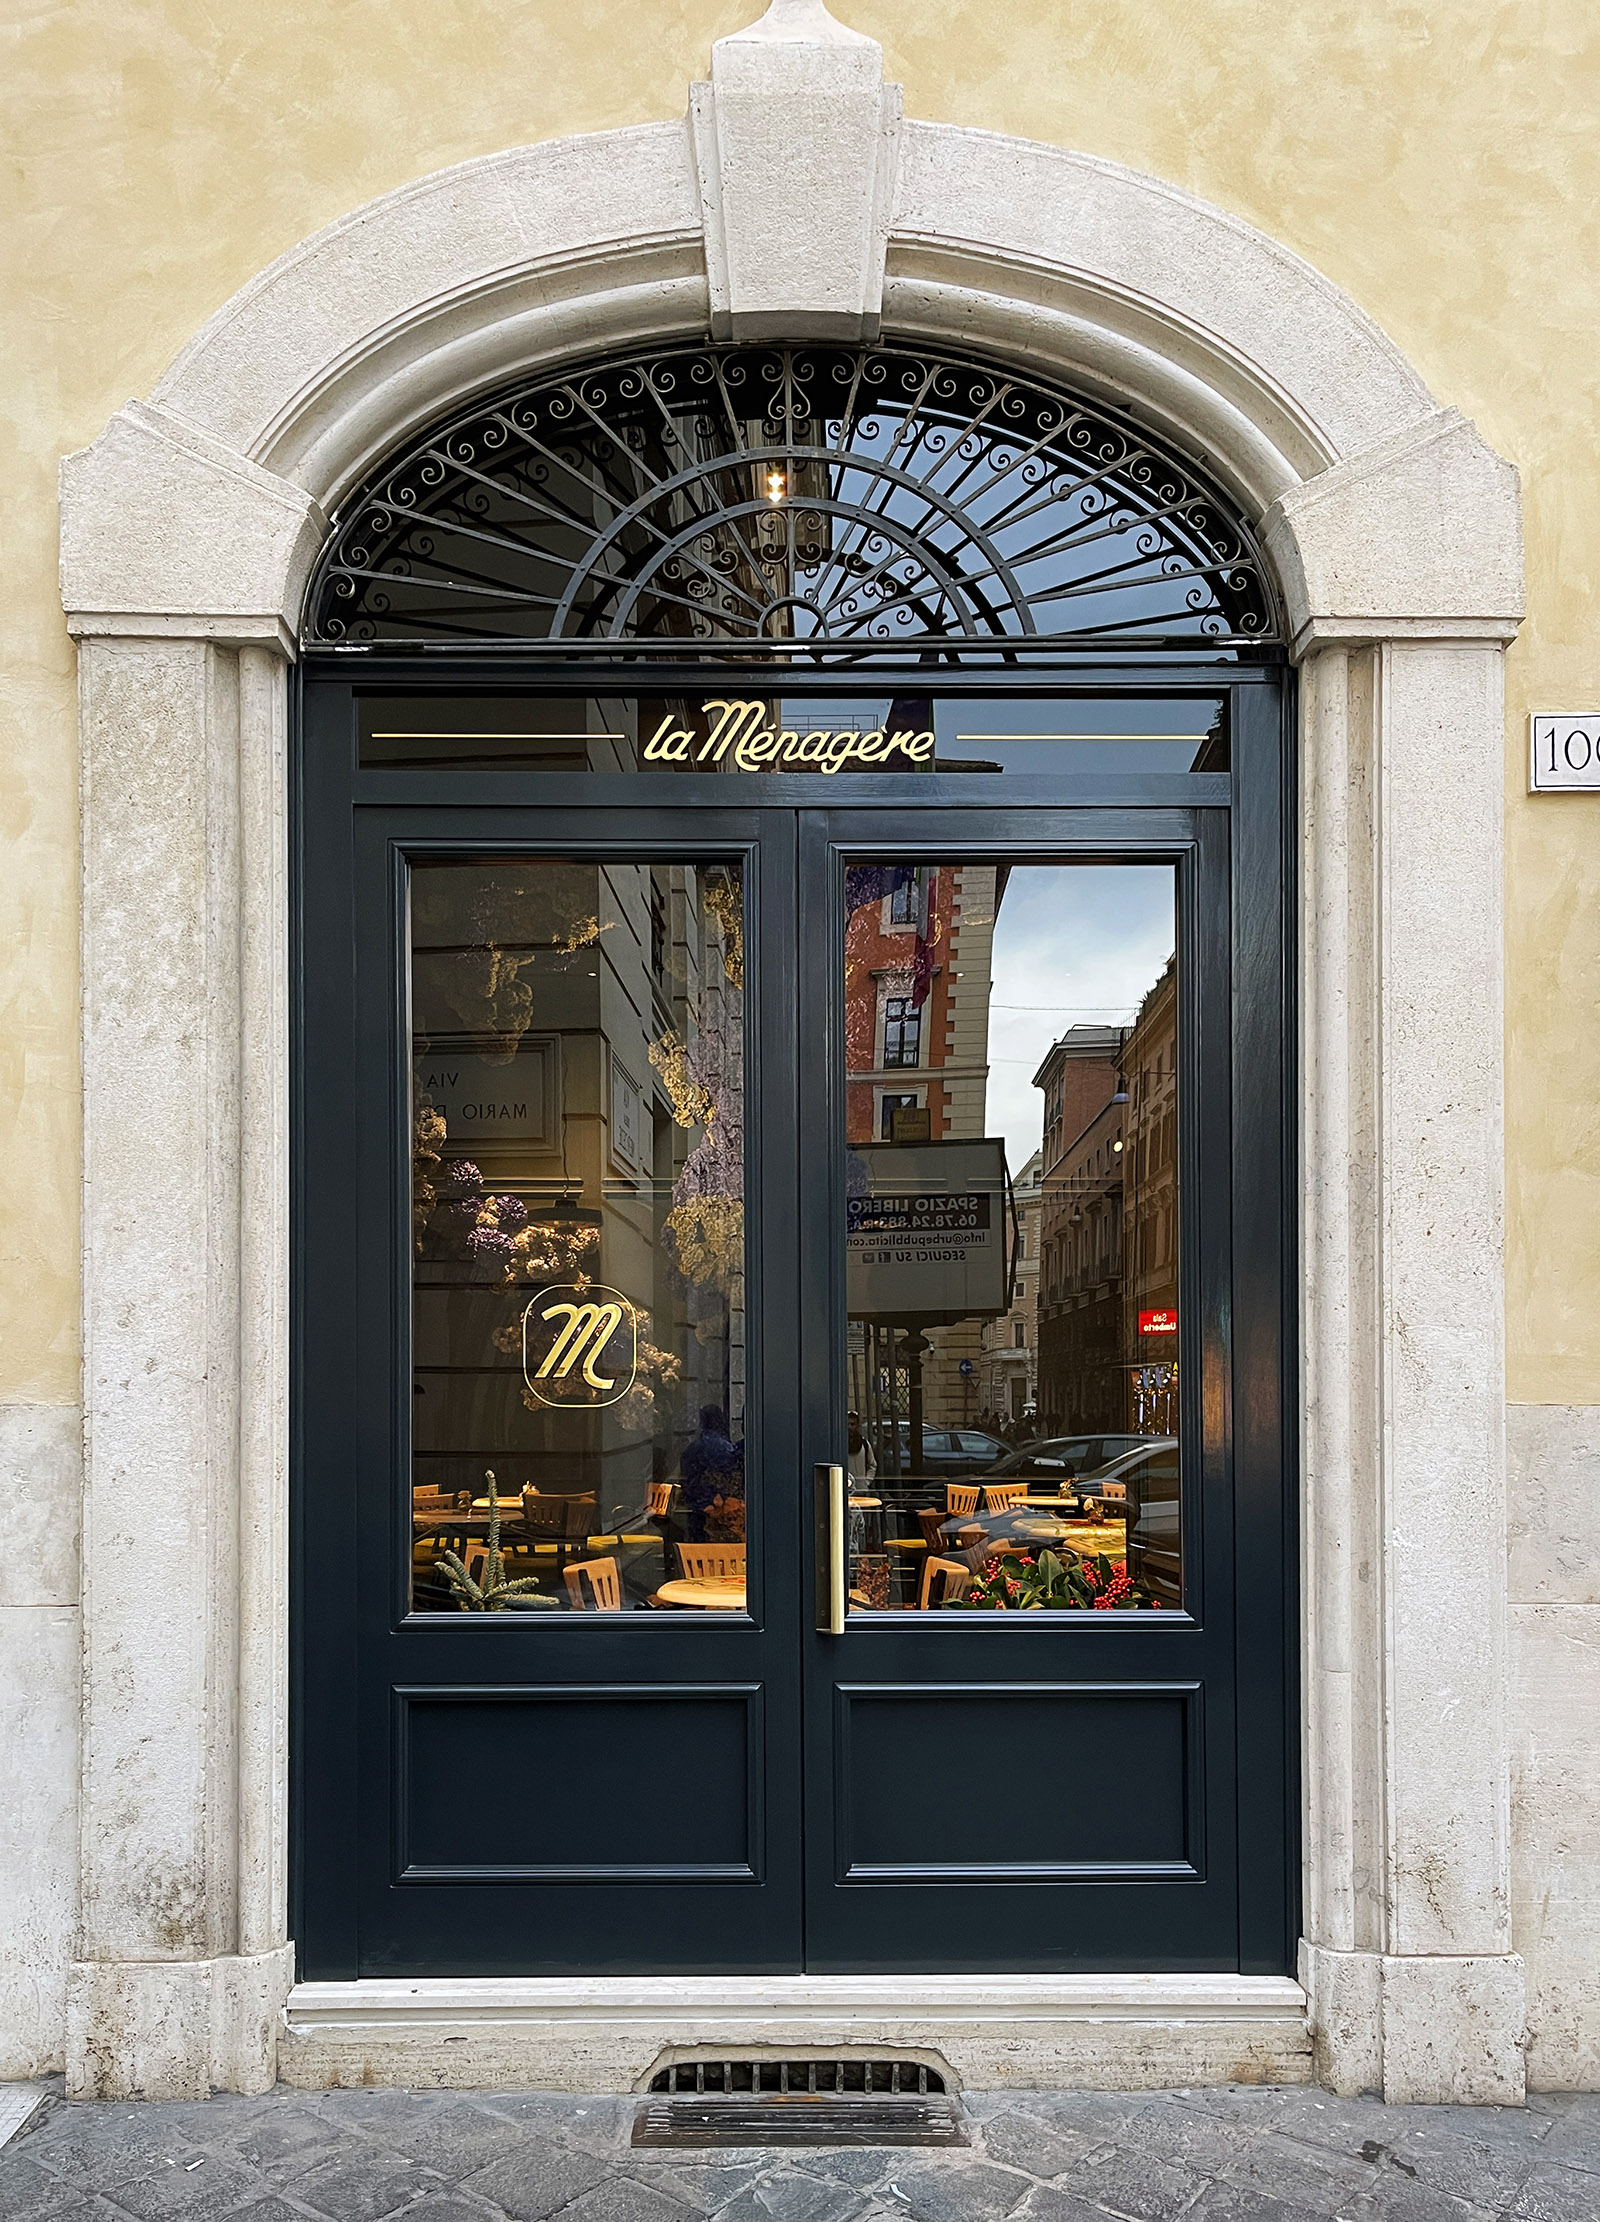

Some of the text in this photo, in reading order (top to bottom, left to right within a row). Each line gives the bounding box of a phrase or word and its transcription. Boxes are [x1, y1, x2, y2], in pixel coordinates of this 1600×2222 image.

[643, 700, 935, 775] la Ménagère
[1544, 727, 1600, 771] 10
